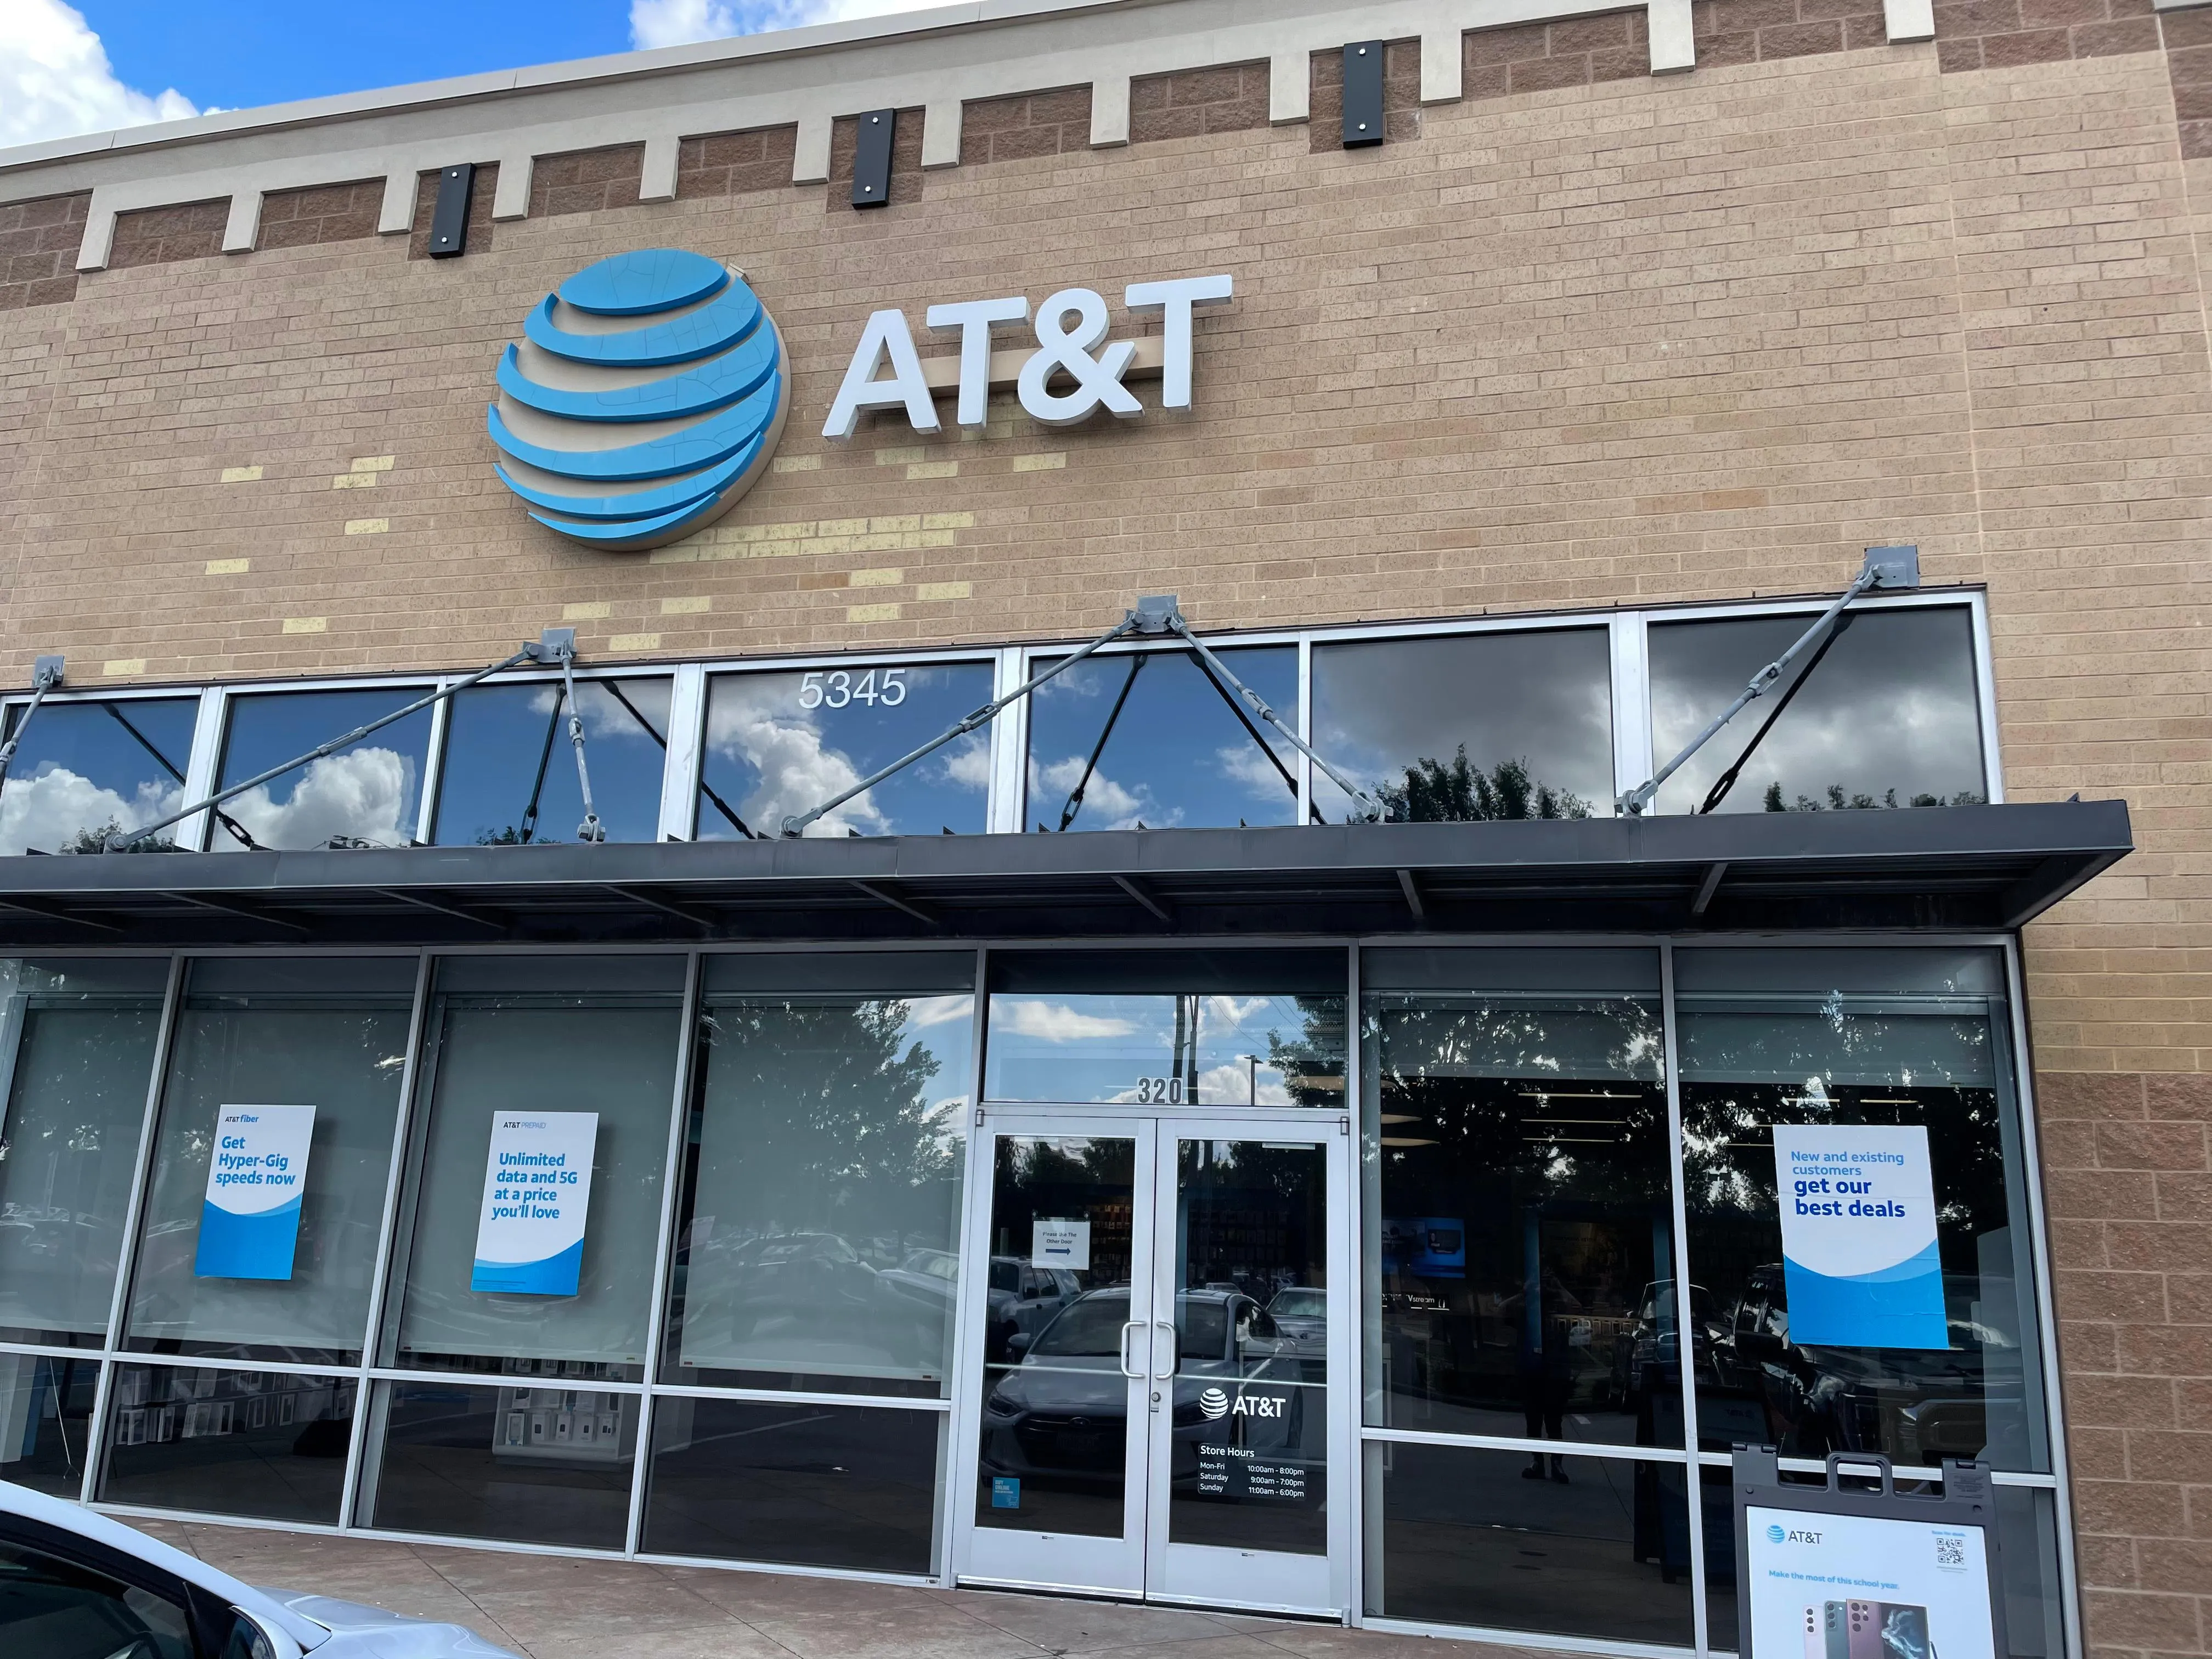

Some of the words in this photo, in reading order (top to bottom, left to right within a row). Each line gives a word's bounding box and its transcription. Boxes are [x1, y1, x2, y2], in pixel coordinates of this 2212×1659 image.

[821, 274, 1234, 443] AT&T
[798, 668, 906, 709] 5345
[1138, 1077, 1182, 1104] 320
[240, 1114, 259, 1122] fiber
[222, 1136, 246, 1149] Get
[218, 1153, 289, 1171] Hyper-Gig
[499, 1152, 566, 1166] Unlimited
[1791, 1151, 1820, 1161] New
[1824, 1151, 1848, 1162] and
[1851, 1152, 1904, 1166] existing
[496, 1169, 528, 1183] data
[531, 1170, 557, 1183] and
[559, 1171, 578, 1184] 5G
[1792, 1165, 1862, 1176] customers
[215, 1170, 263, 1187] speeds
[266, 1174, 296, 1185] now
[1794, 1178, 1831, 1197] get
[1836, 1181, 1872, 1194] our
[494, 1188, 509, 1200] at
[512, 1190, 520, 1200] a
[522, 1187, 557, 1204] price
[491, 1204, 529, 1220] you'll
[532, 1205, 560, 1218] love
[1795, 1198, 1843, 1216] best
[1848, 1199, 1905, 1217] deals
[1232, 1395, 1286, 1418] AT&T
[1200, 1446, 1226, 1455] Store
[1227, 1447, 1255, 1457] Hours
[1200, 1462, 1225, 1470] Mon-Fri
[1247, 1465, 1274, 1474] 10:00am
[1279, 1467, 1304, 1476] 8:00pm
[1200, 1472, 1229, 1482] Saturday
[1250, 1476, 1275, 1485] 9:00am
[1280, 1479, 1304, 1487] 7:00pm
[1200, 1483, 1223, 1493] Sunday
[1248, 1487, 1274, 1495] 11:00am
[1279, 1489, 1305, 1498] 6:00pm
[1788, 1530, 1822, 1544] AT&T
[1769, 1570, 1790, 1578] Make
[1791, 1572, 1804, 1580] the
[1805, 1575, 1826, 1583] most
[1837, 1577, 1852, 1585] this
[1854, 1579, 1880, 1588] school
